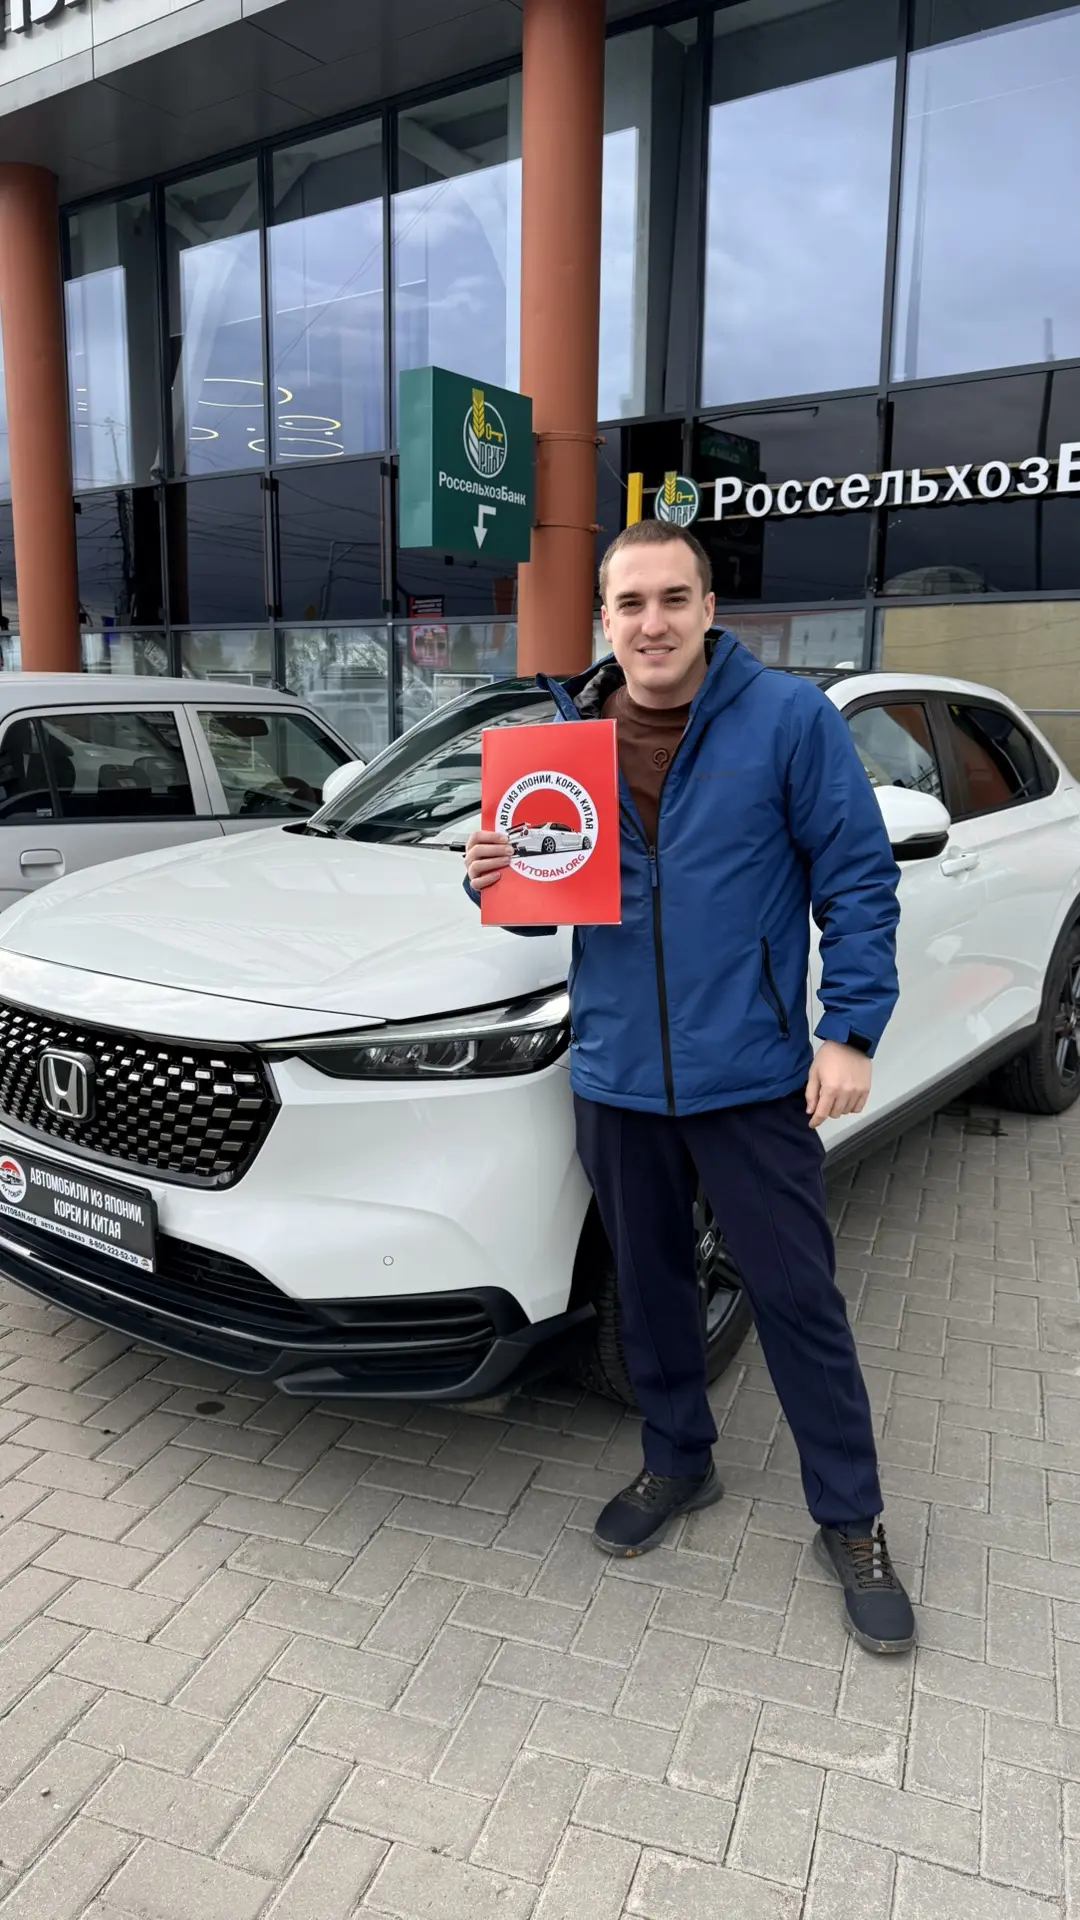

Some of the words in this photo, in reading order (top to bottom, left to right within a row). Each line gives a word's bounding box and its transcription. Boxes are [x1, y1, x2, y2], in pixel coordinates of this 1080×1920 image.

[438, 470, 527, 506] РоссельхозБанк
[713, 441, 1080, 521] РоссельхозБ
[500, 803, 512, 826] АВТО
[507, 791, 519, 803] ИЗ
[579, 798, 594, 830] КИТАЯ
[514, 854, 586, 878] AVTOBAN.ORG
[30, 1167, 90, 1204] АВТОМОБИЛИ
[90, 1188, 103, 1208] ИЗ
[104, 1193, 145, 1227] ЯПОНИИ,
[53, 1197, 82, 1225] КОРЕИ
[82, 1208, 90, 1228] И
[90, 1211, 122, 1240] КИТАЯ
